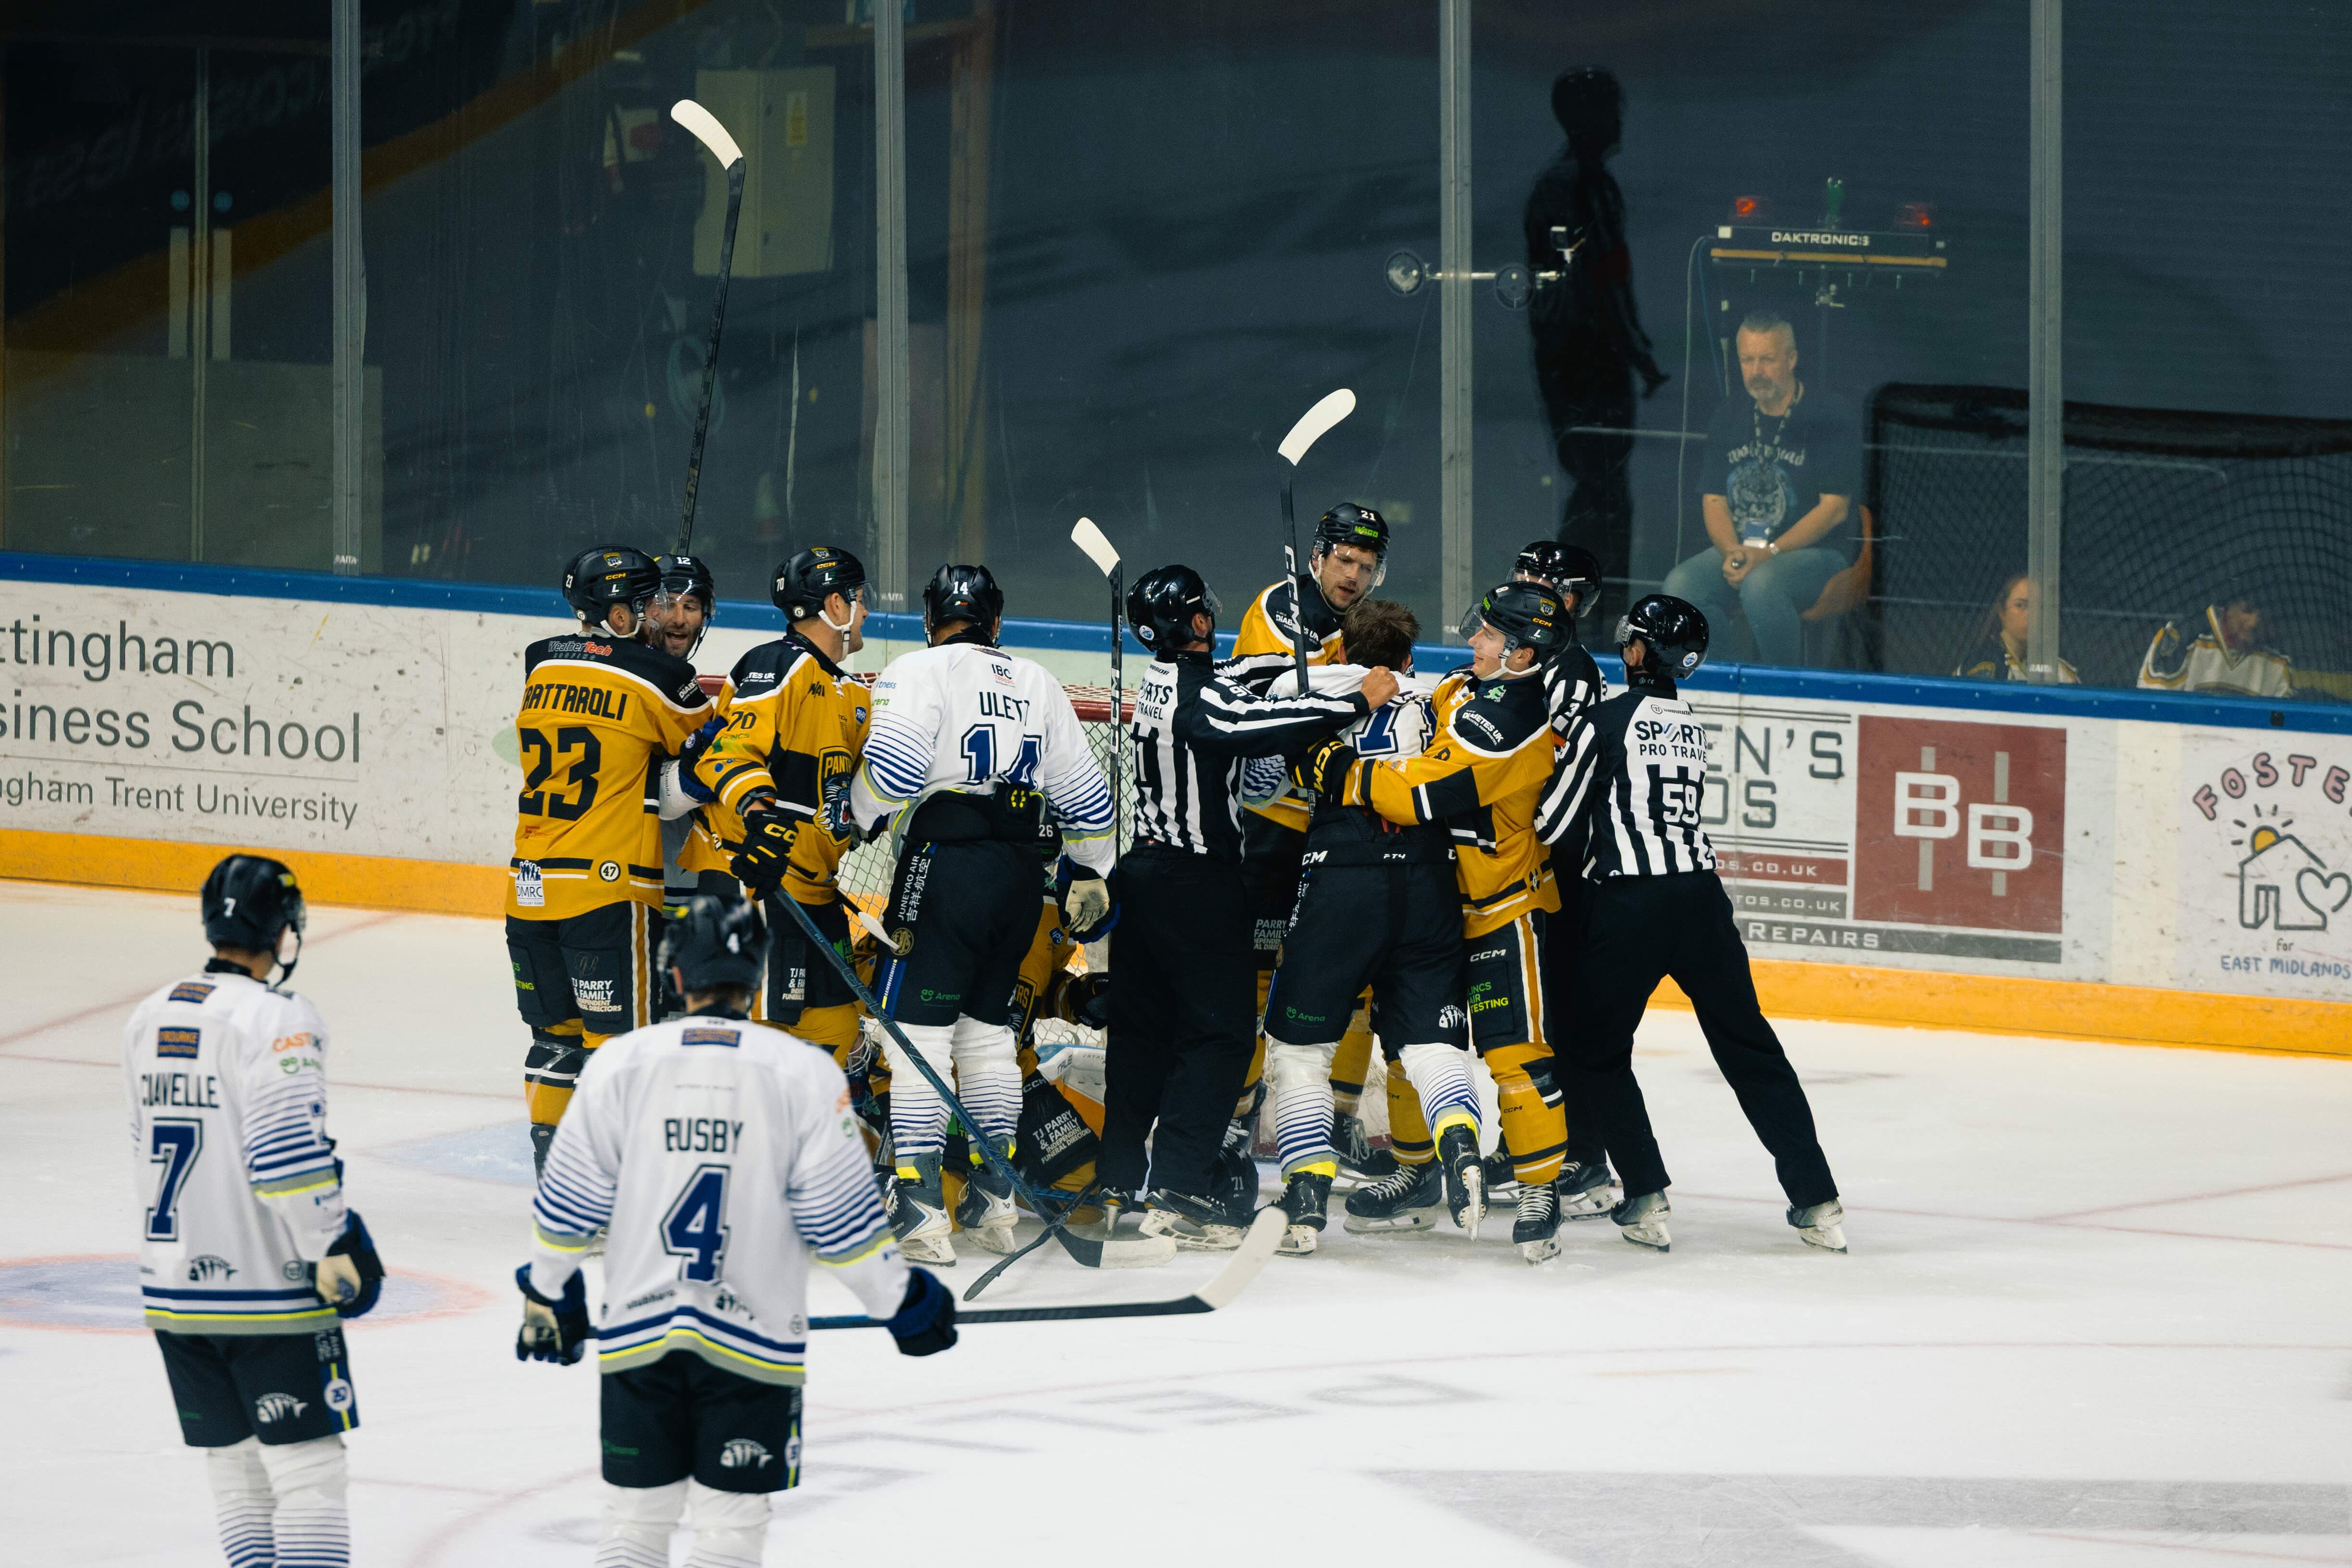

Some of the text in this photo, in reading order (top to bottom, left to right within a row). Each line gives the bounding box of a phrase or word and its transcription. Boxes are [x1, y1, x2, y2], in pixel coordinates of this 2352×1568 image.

[1772, 231, 1869, 246] DAKTRONICS
[1361, 510, 1376, 521] 21
[1354, 526, 1378, 538] WAGO
[677, 557, 691, 566] 12
[776, 578, 785, 592] 70
[953, 581, 968, 595] 14
[1285, 545, 1301, 635] CCM
[1532, 617, 1552, 627] CCM
[0, 614, 234, 681] tingham
[548, 641, 613, 656] WeatherTech
[991, 664, 1012, 680] IBC
[1137, 701, 1163, 720] TRAVEL
[1664, 708, 1691, 716] WARRIOR
[0, 689, 360, 762] iness School
[726, 711, 757, 732] 70
[1492, 729, 1504, 744] UK
[961, 724, 1042, 790] 14
[1640, 744, 1667, 756] PRO
[519, 726, 602, 822] 23
[0, 771, 358, 830] gham Trent University
[1662, 783, 1701, 828] 59
[1039, 824, 1054, 837] 26
[603, 866, 617, 877] 47
[898, 855, 920, 921] JUNEYAO AIR
[906, 858, 931, 922] 吉祥航空
[224, 898, 236, 917] 7
[1256, 919, 1287, 929] PARRY
[1748, 921, 1879, 948] REPAIRS
[726, 932, 740, 954] 4
[1469, 949, 1506, 962] CCM
[790, 968, 798, 978] TJ
[2221, 955, 2352, 979] EAST MIDLANDS
[579, 980, 614, 990] PARRY
[788, 978, 796, 988] &
[579, 989, 615, 1000] FAMILY
[1469, 992, 1481, 1003] AIR
[1470, 997, 1509, 1014] TESTING
[1298, 1013, 1325, 1021] Arena
[1023, 1078, 1047, 1093] CCM
[1504, 1105, 1523, 1114] CCM
[1033, 1109, 1073, 1141] TJ PARRY
[1040, 1117, 1080, 1150] & FAMILY
[1046, 1126, 1081, 1153] INDEPENDENT
[1041, 1128, 1092, 1164] FUNERAL DIRECTORS
[145, 1116, 204, 1242] 7
[1231, 1177, 1244, 1191] 71
[660, 1163, 730, 1284] 4
